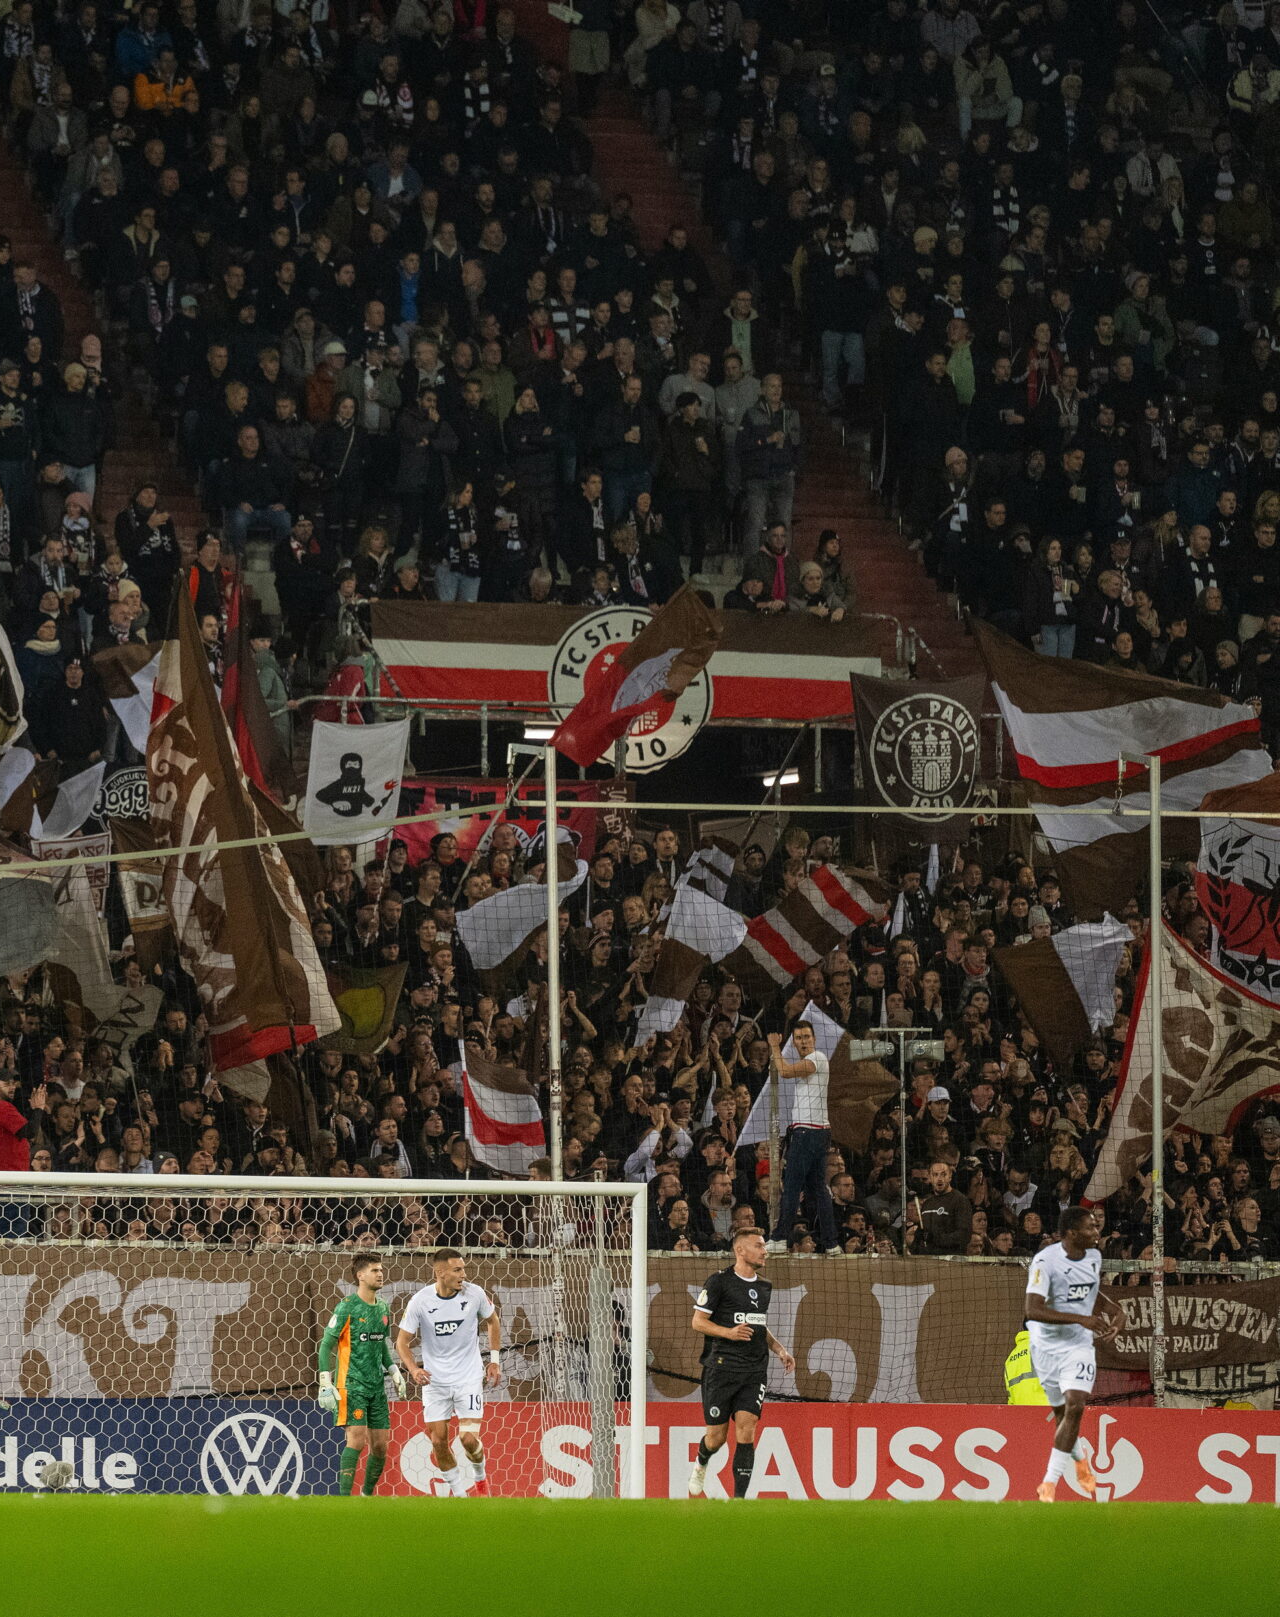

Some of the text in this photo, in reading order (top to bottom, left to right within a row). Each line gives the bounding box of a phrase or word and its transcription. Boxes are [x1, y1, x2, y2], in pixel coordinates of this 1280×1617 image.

[560, 646, 588, 679] FC
[583, 621, 622, 649] ST.
[876, 700, 975, 754] FC ST. PAULI
[1068, 1286, 1091, 1299] SAP
[434, 1322, 458, 1335] SAP
[1166, 1295, 1277, 1344] WESTEN
[1114, 1333, 1220, 1354] SANT PAULI
[1075, 1362, 1095, 1382] 29
[758, 1383, 766, 1400] 5
[469, 1394, 482, 1411] 19
